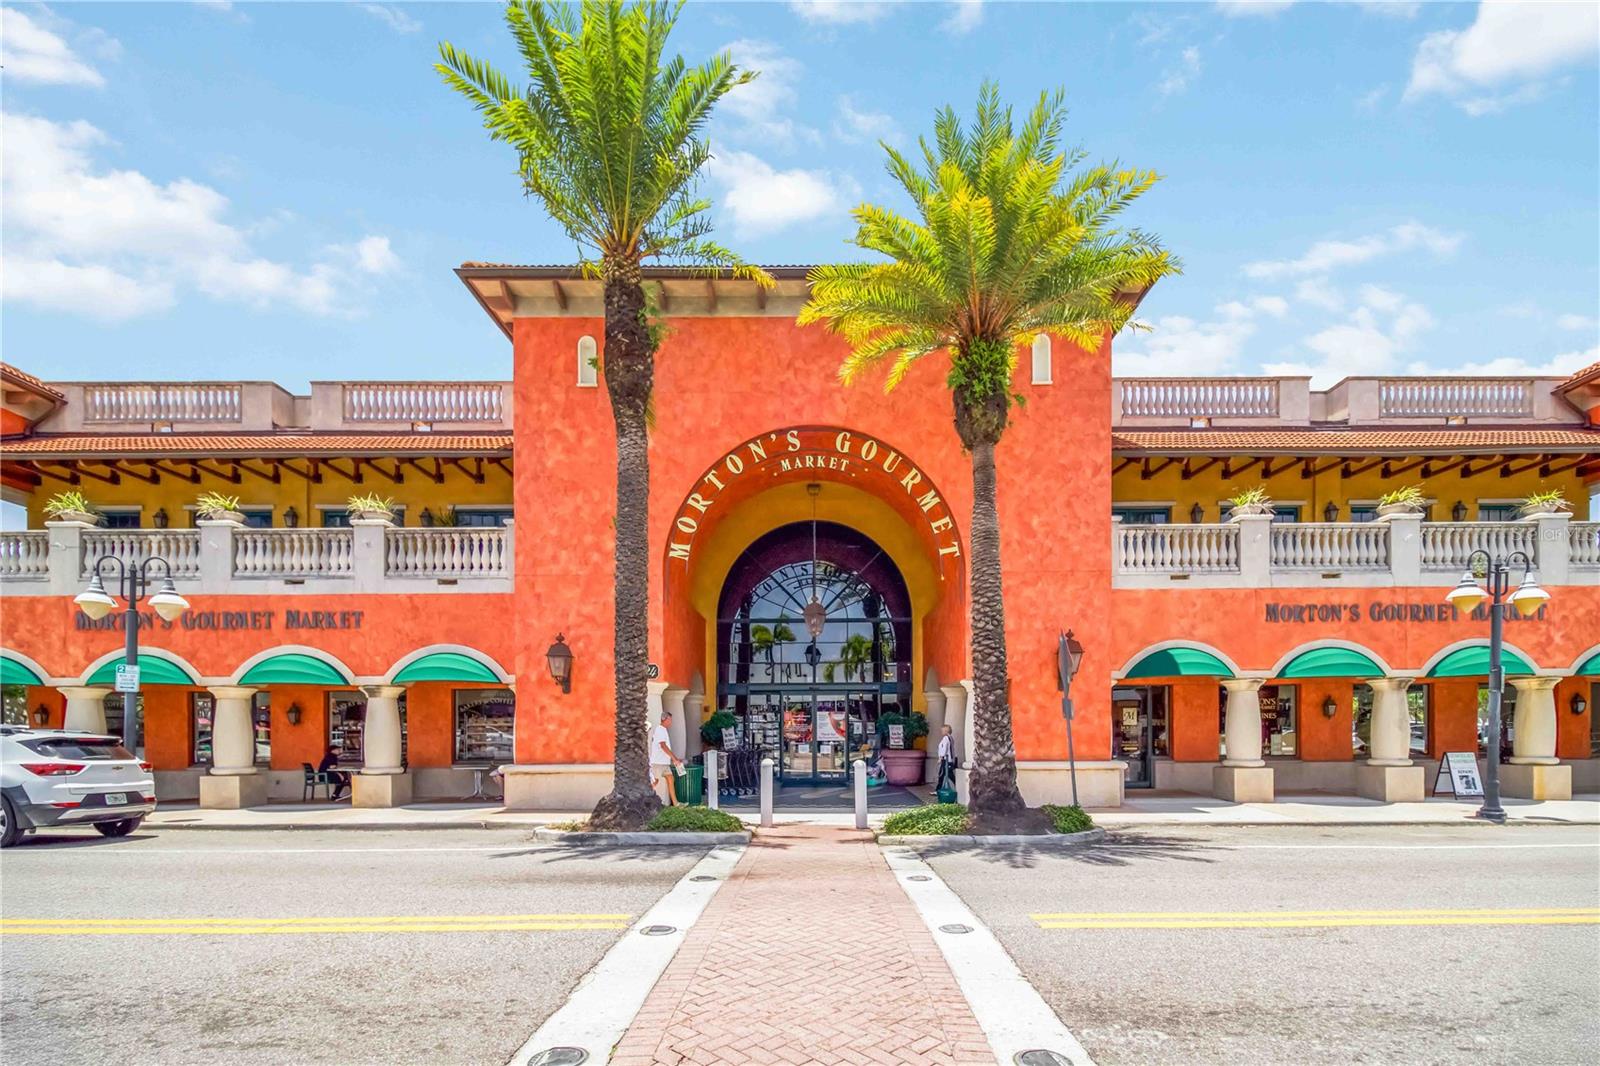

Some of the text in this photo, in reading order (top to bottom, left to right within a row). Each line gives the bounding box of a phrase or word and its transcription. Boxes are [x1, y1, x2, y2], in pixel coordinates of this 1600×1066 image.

[780, 455, 850, 472] MARKET
[668, 430, 961, 561] MORTON'S GOURMET
[181, 609, 276, 630] GOURMET
[285, 609, 365, 630] MARKET
[1265, 602, 1361, 623] MORTON'S
[1369, 602, 1460, 623] GOURMET
